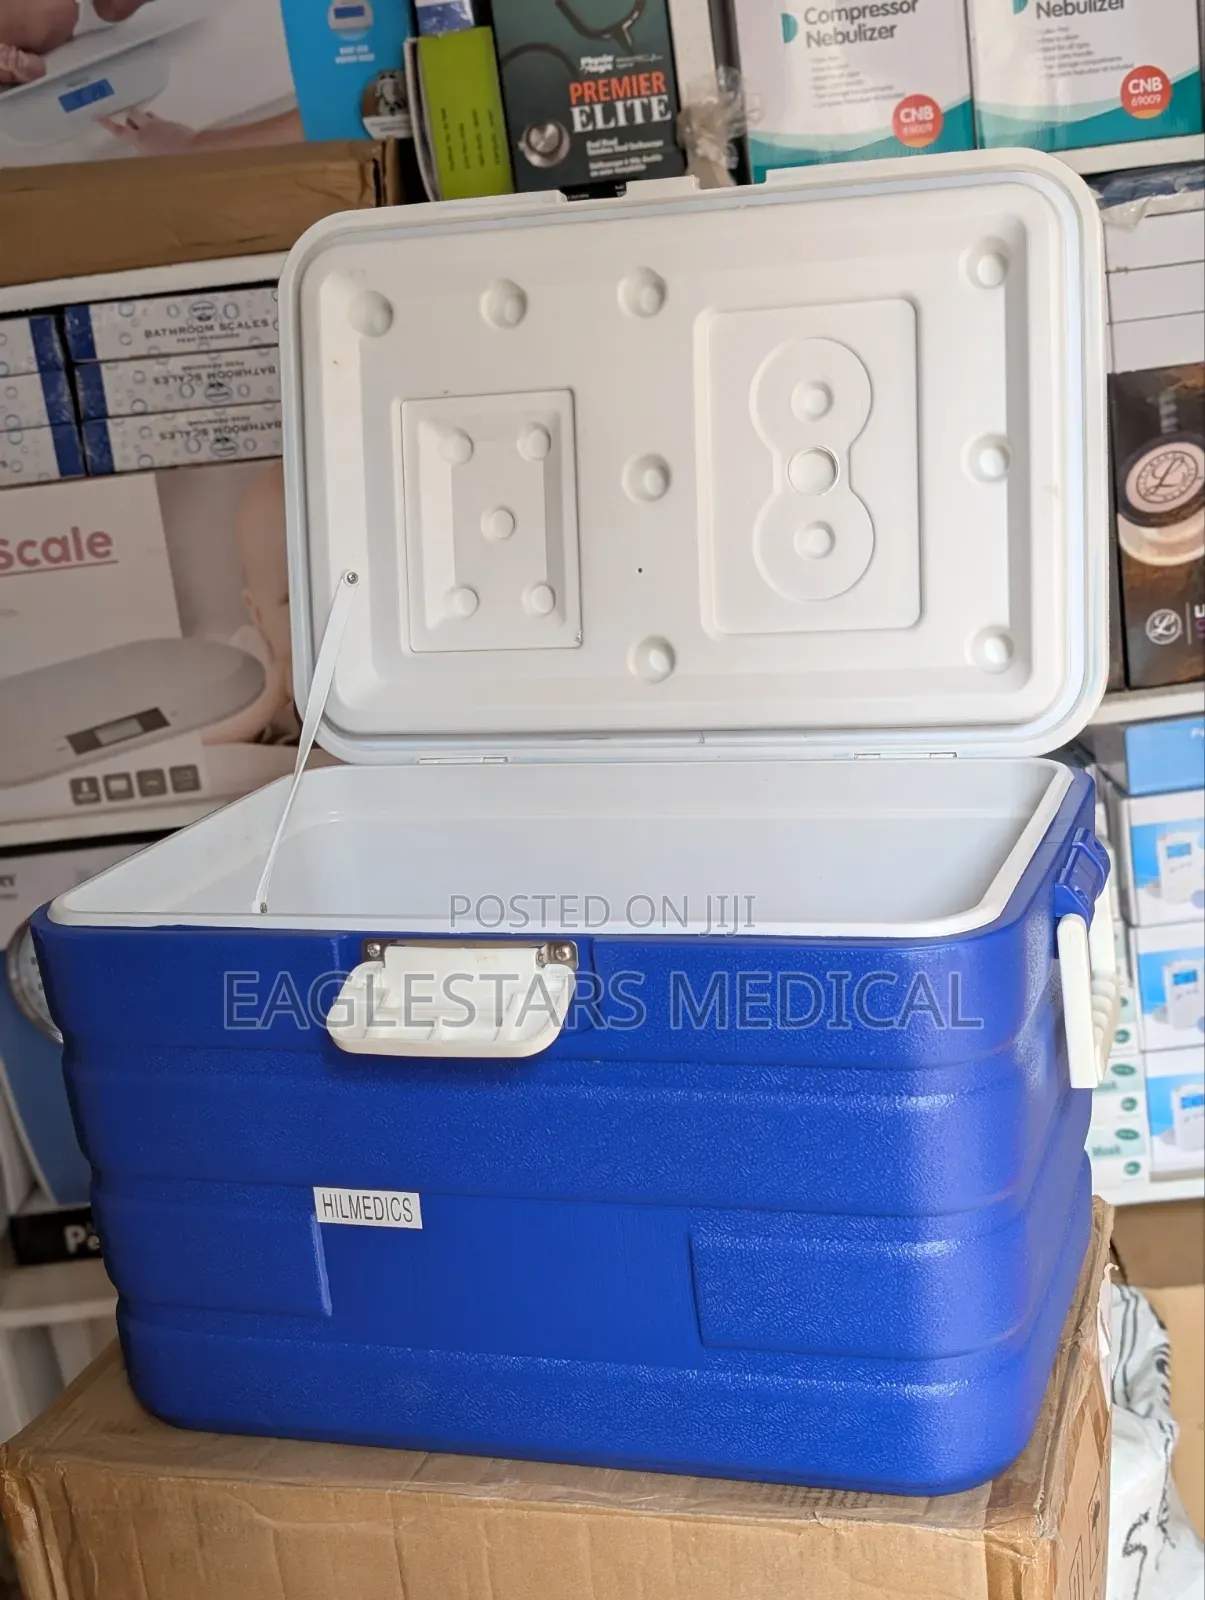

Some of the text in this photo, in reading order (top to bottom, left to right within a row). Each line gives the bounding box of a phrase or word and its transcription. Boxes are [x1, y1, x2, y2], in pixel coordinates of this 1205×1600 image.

[804, 0, 919, 26] Compressor
[805, 24, 898, 49] Nebulizer
[568, 71, 667, 105] PREMIER
[1128, 77, 1163, 94] CNB
[1130, 95, 1162, 107] 69009
[569, 95, 673, 133] ELITE
[899, 105, 935, 123] CNB
[144, 323, 215, 340] BATHROOM
[219, 318, 270, 333] SCALES
[321, 1192, 414, 1223] HILMEDICS
